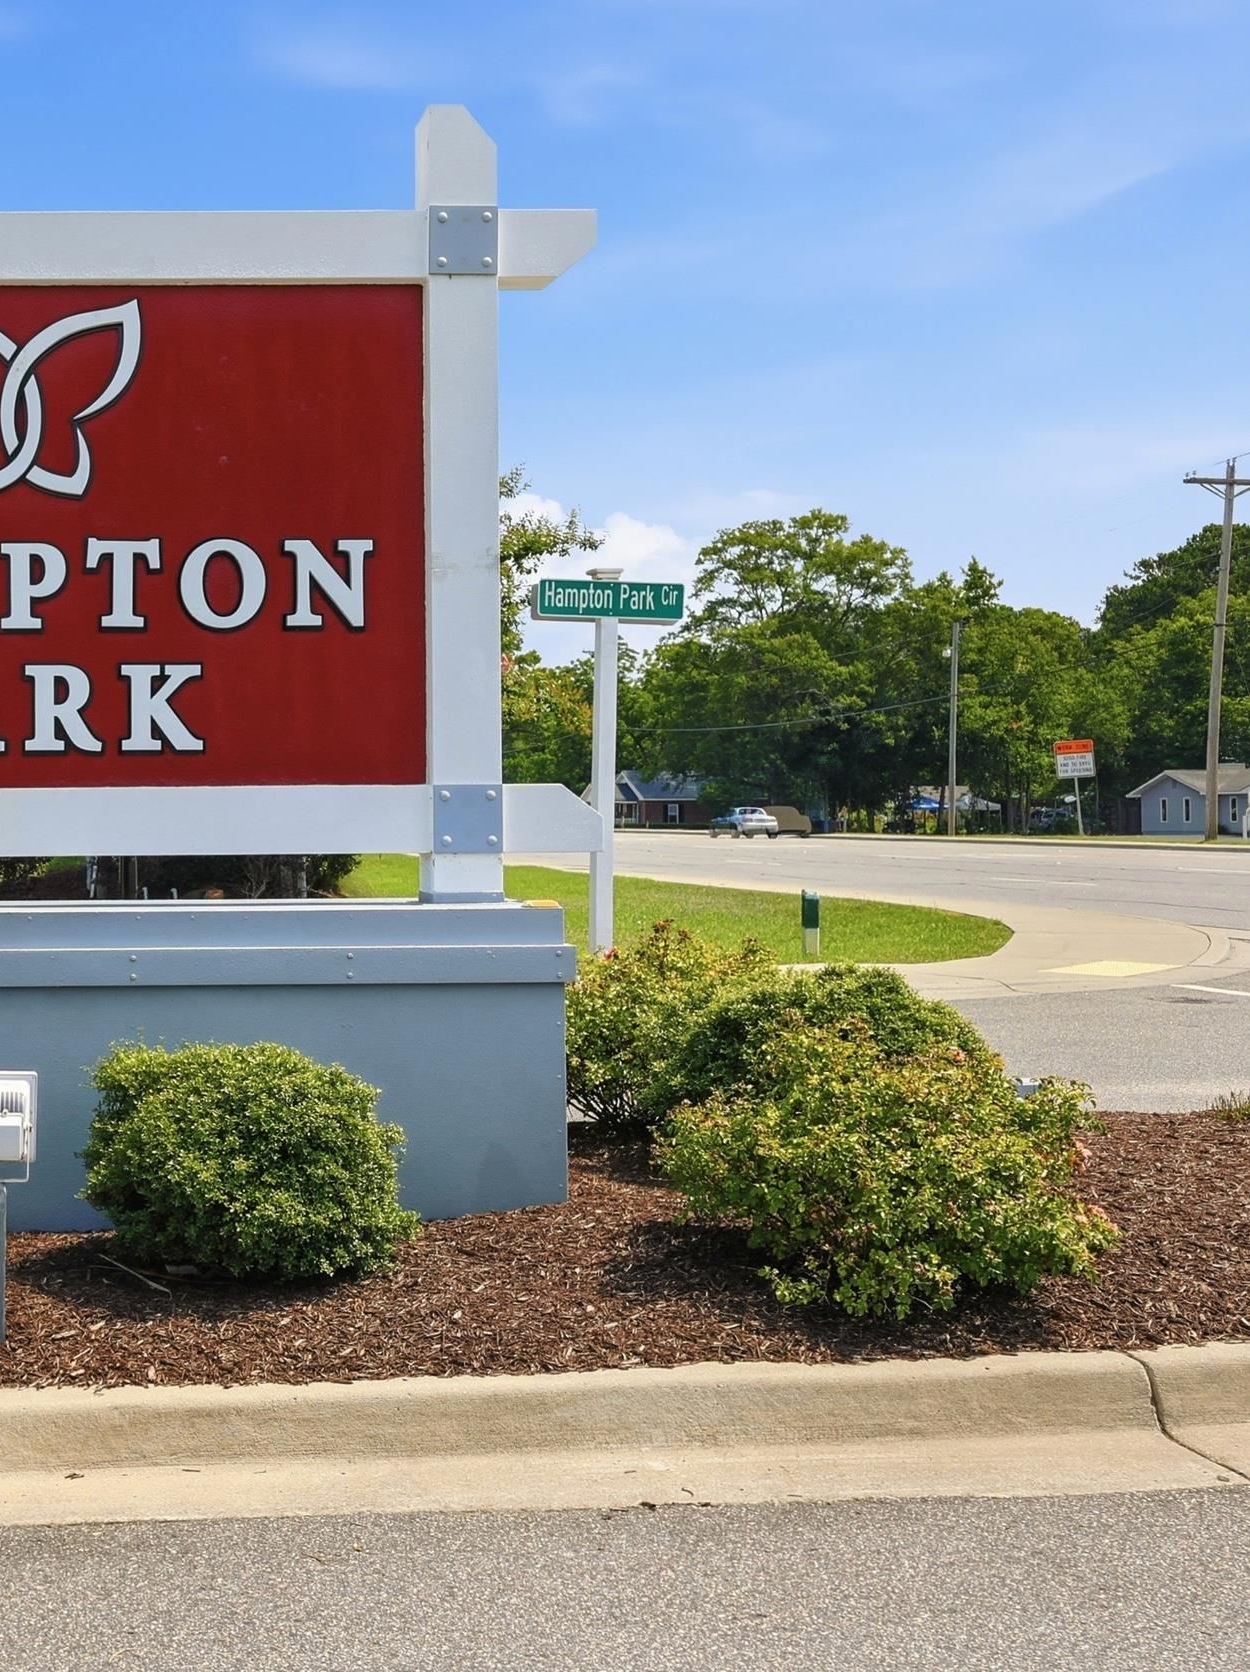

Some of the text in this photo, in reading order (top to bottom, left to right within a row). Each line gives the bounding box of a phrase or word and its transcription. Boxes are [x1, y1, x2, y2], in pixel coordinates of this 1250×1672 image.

[544, 581, 678, 614] Hampton Park Cir
